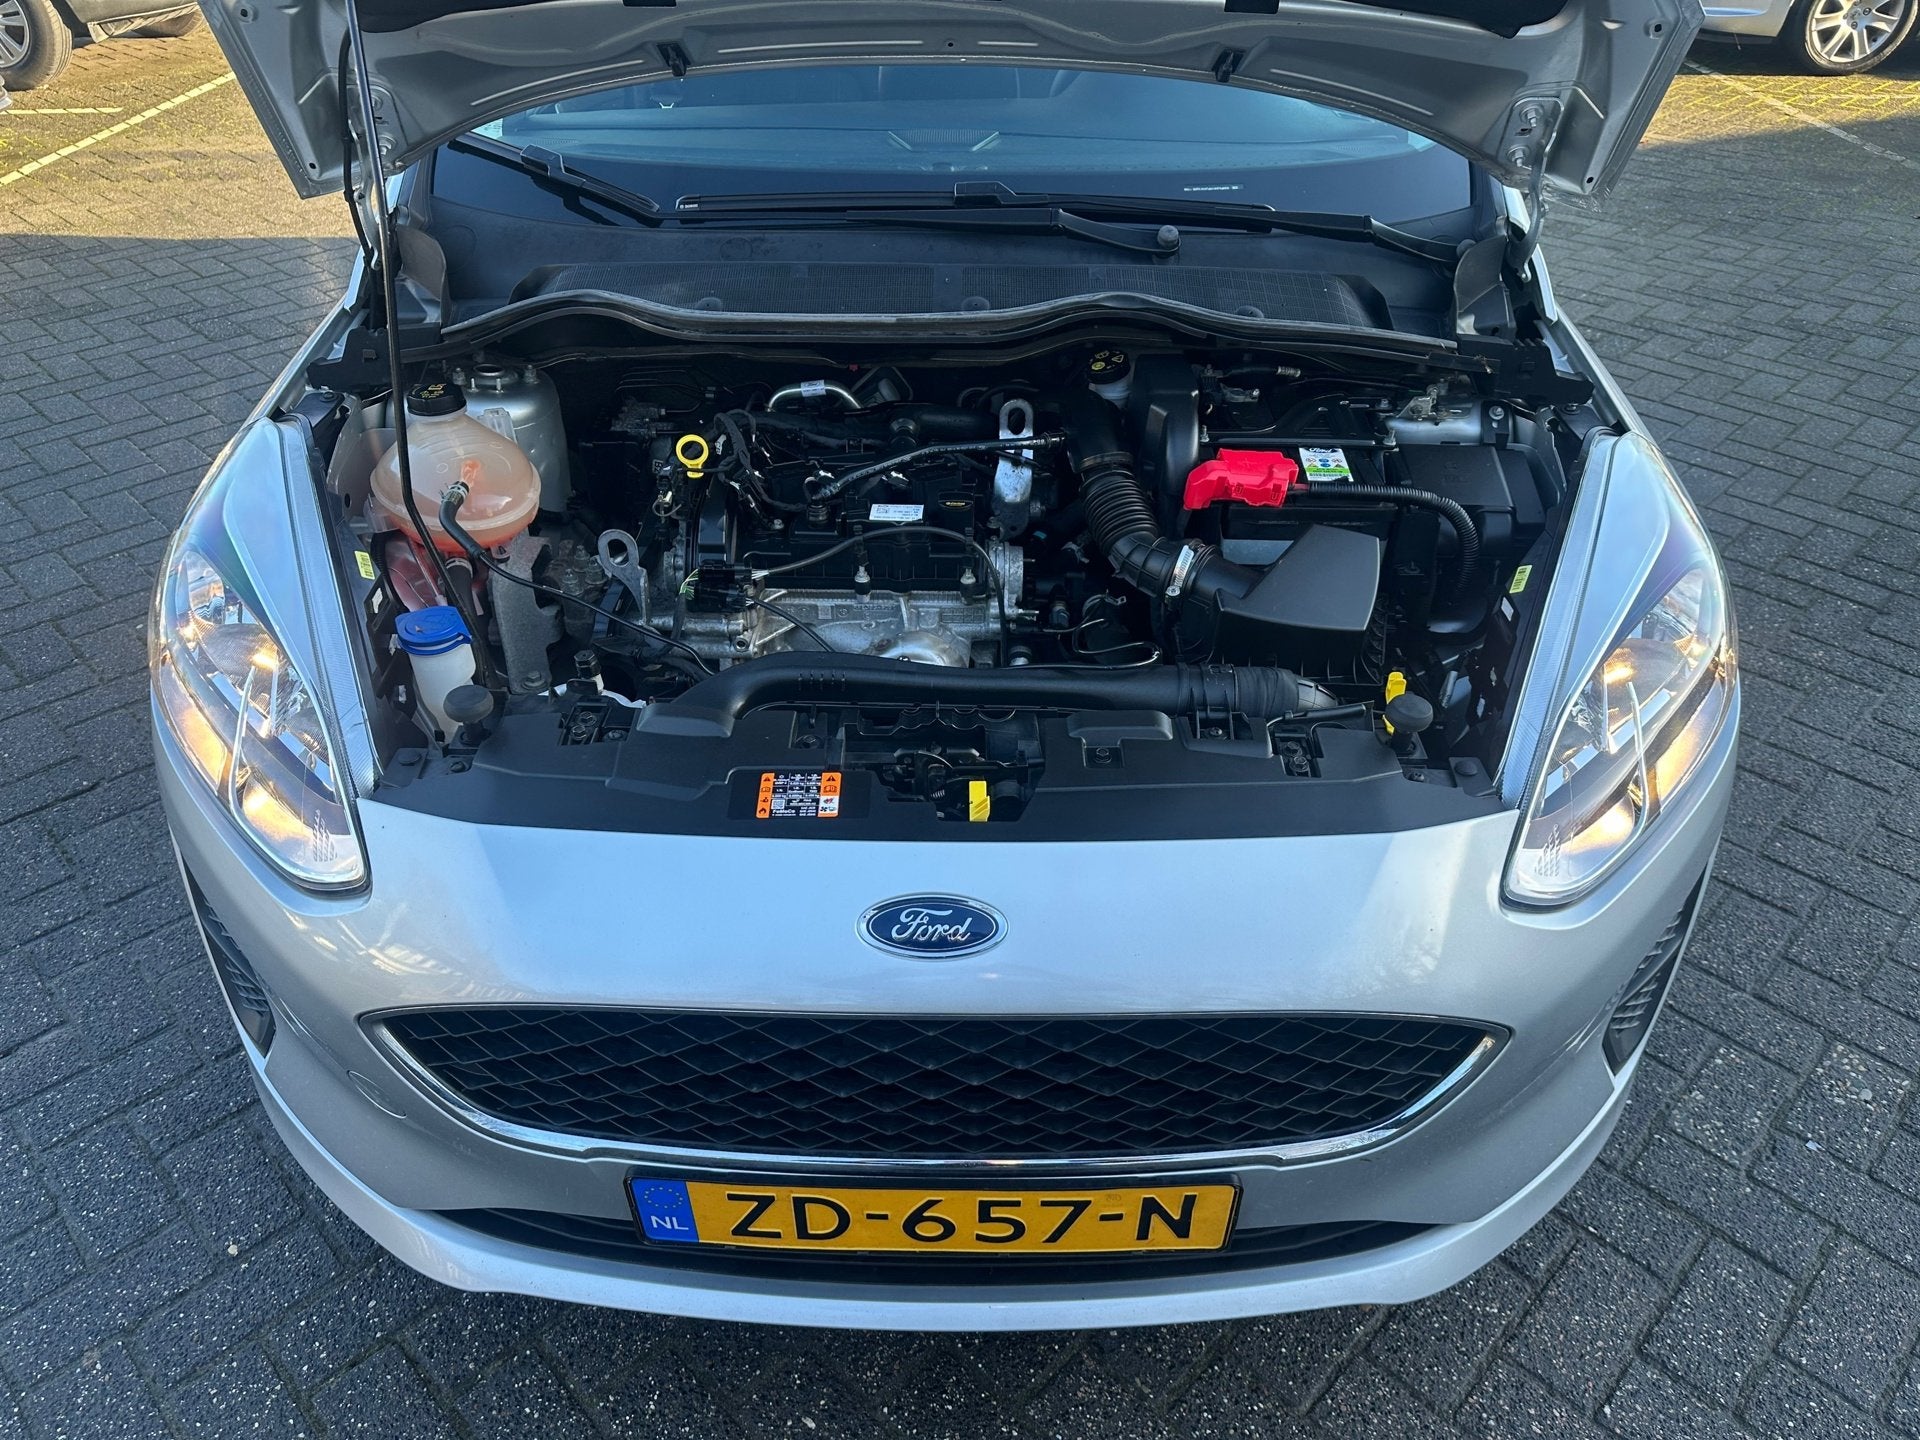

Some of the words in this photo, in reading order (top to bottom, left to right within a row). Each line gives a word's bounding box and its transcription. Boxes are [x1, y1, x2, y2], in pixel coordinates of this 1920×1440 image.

[891, 907, 973, 941] Ford
[650, 1215, 690, 1231] NL
[726, 1192, 1198, 1244] ZD-657-N
